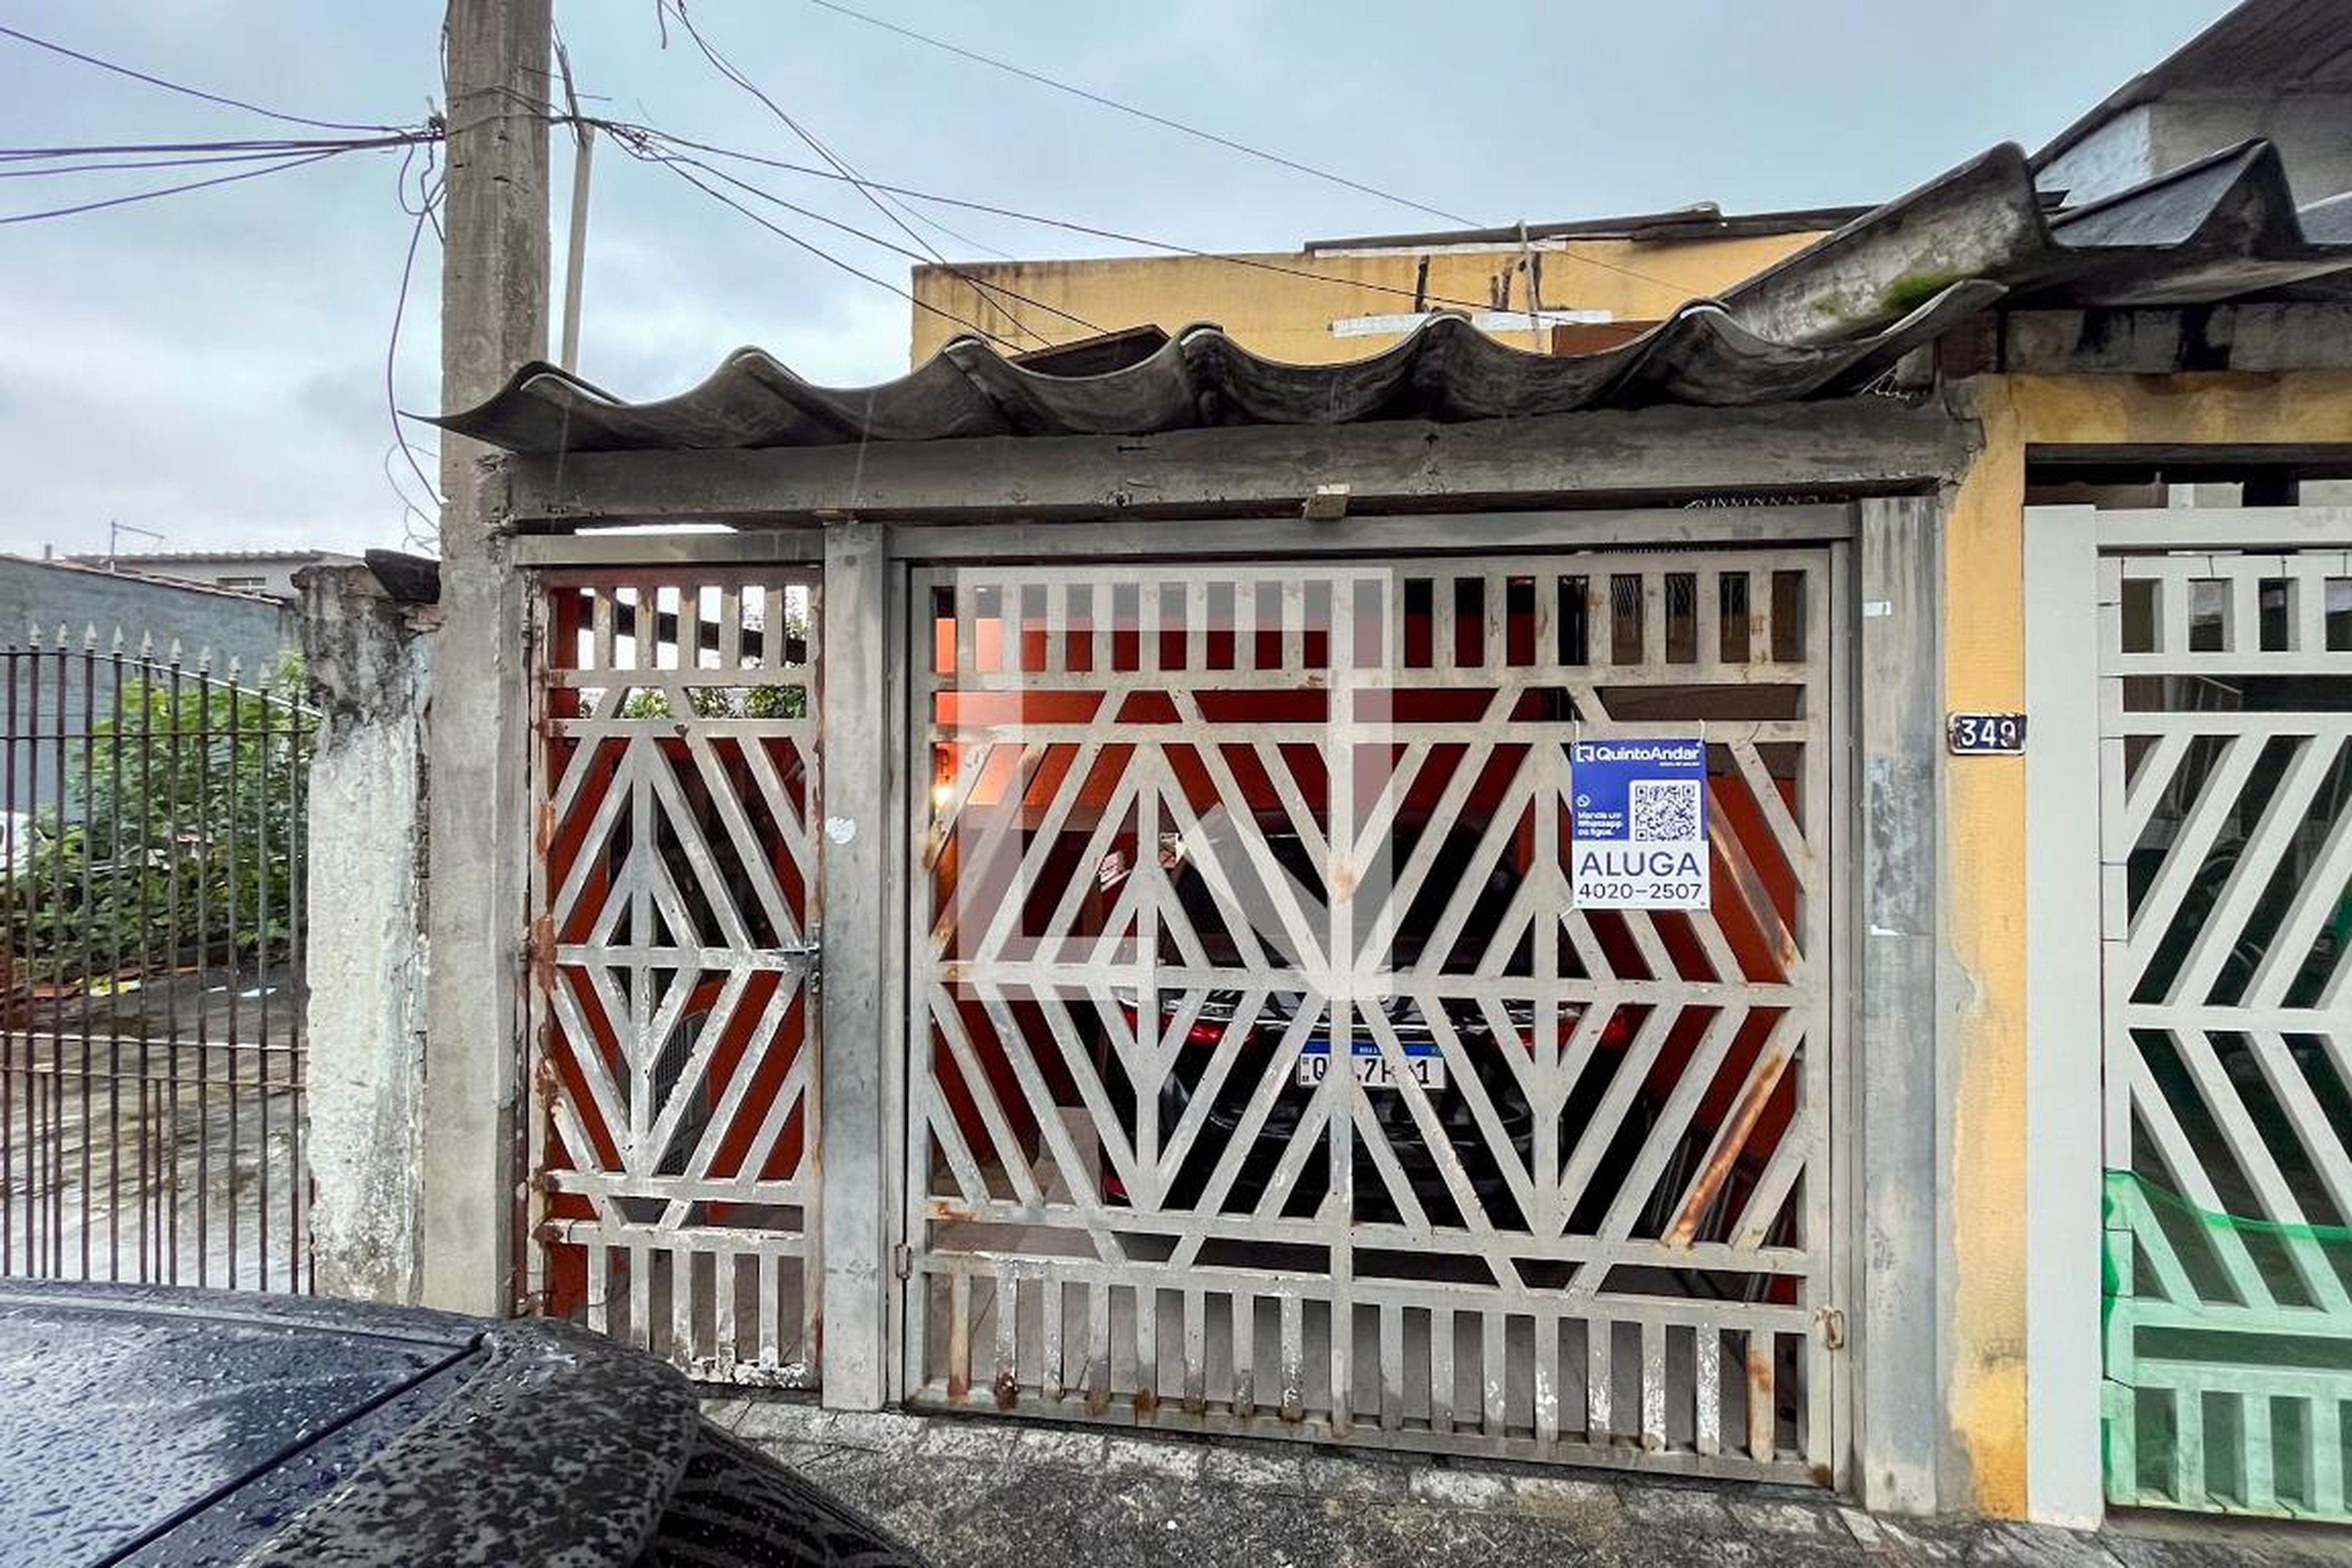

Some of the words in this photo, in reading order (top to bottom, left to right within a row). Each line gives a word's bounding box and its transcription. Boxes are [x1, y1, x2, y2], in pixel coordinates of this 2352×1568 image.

[1961, 718, 2016, 747] 349
[1596, 746, 1700, 761] QuintoAndar
[1580, 851, 1701, 876] ALUGA
[1579, 883, 1702, 899] 4020-2507
